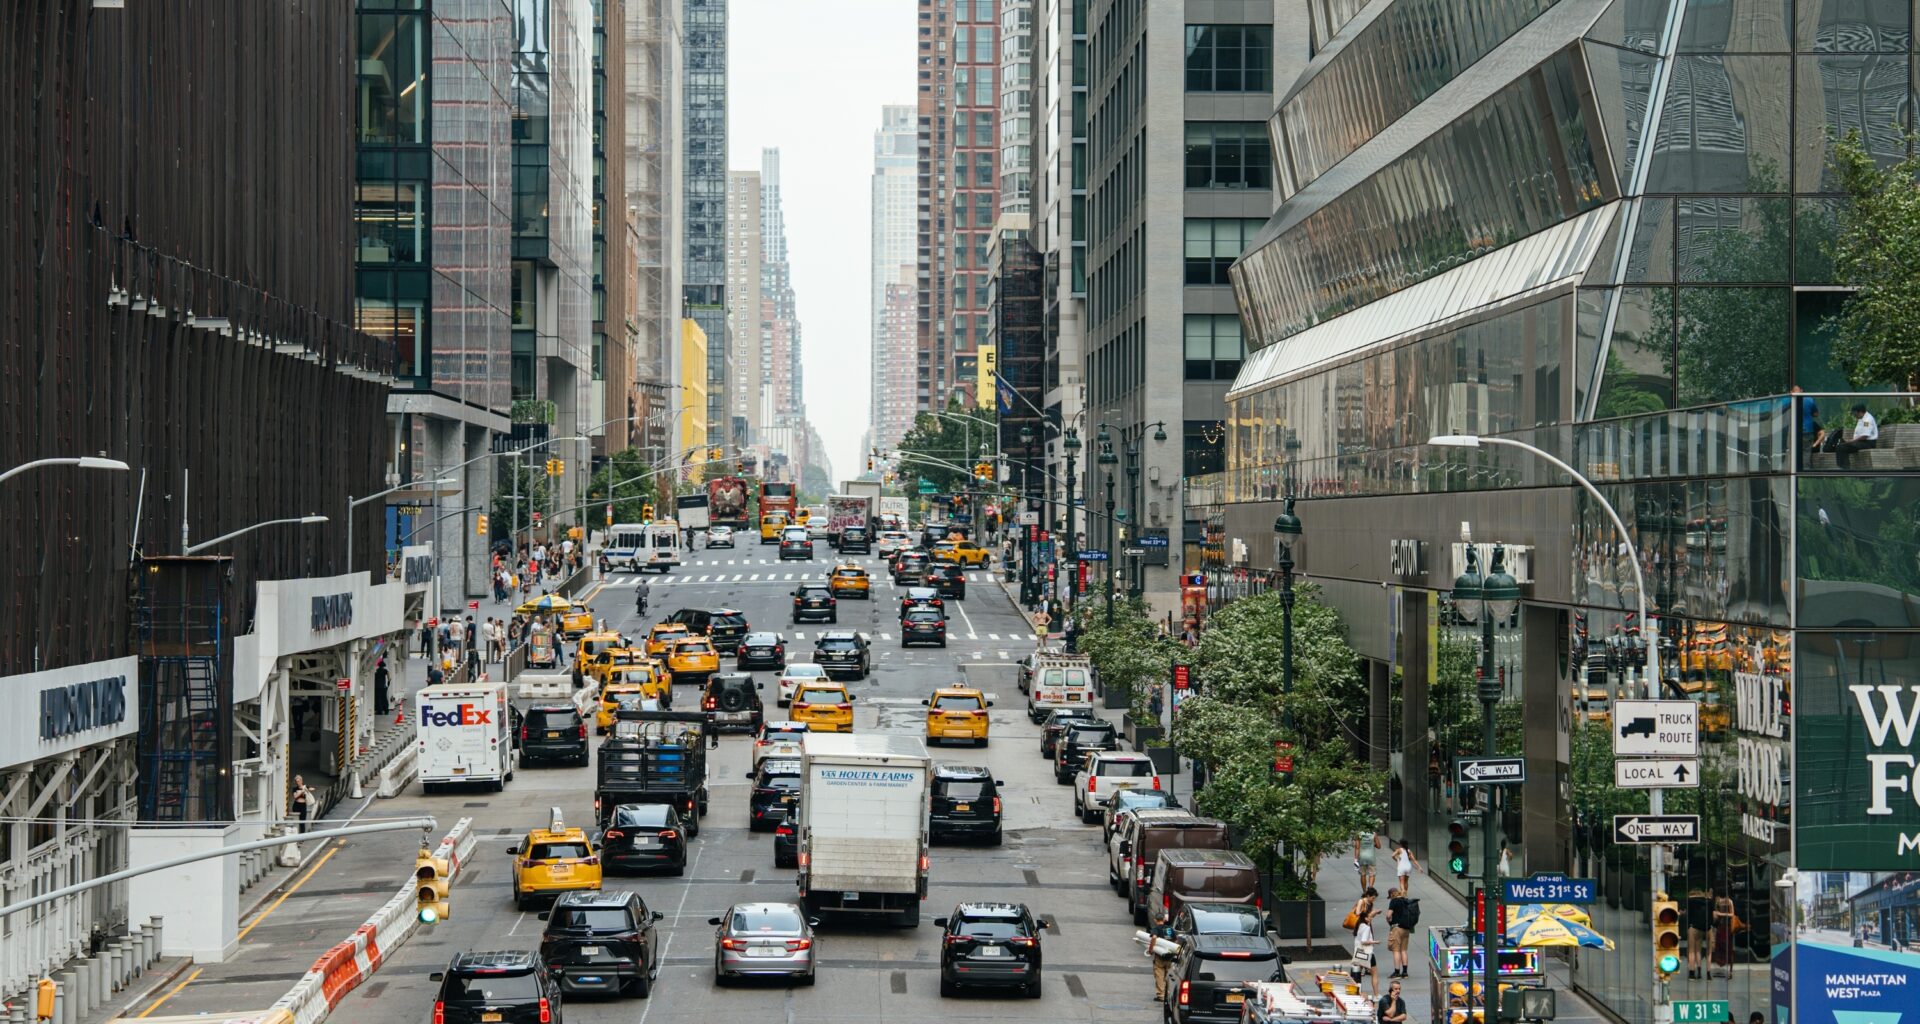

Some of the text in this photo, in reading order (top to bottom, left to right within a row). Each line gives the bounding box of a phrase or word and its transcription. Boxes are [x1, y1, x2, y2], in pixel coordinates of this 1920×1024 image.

[1391, 540, 1417, 576] PELOTON
[1735, 672, 1783, 738] WHOLE
[421, 704, 491, 727] FedEx
[1659, 714, 1692, 725] TRUCK
[1659, 732, 1692, 743] ROUTE
[821, 770, 914, 781] VAN HOUTEN FARMS
[1469, 766, 1514, 776] ONE WAY
[1624, 768, 1664, 779] LOCAL
[1737, 738, 1782, 807] FOODS
[1627, 824, 1687, 835] ONE WAY
[1742, 812, 1775, 845] MARKET
[1511, 884, 1588, 898] West 31st St
[1825, 974, 1907, 985] MANHATTAN
[1826, 988, 1860, 998] WEST
[1679, 1003, 1721, 1019] W 31 St
